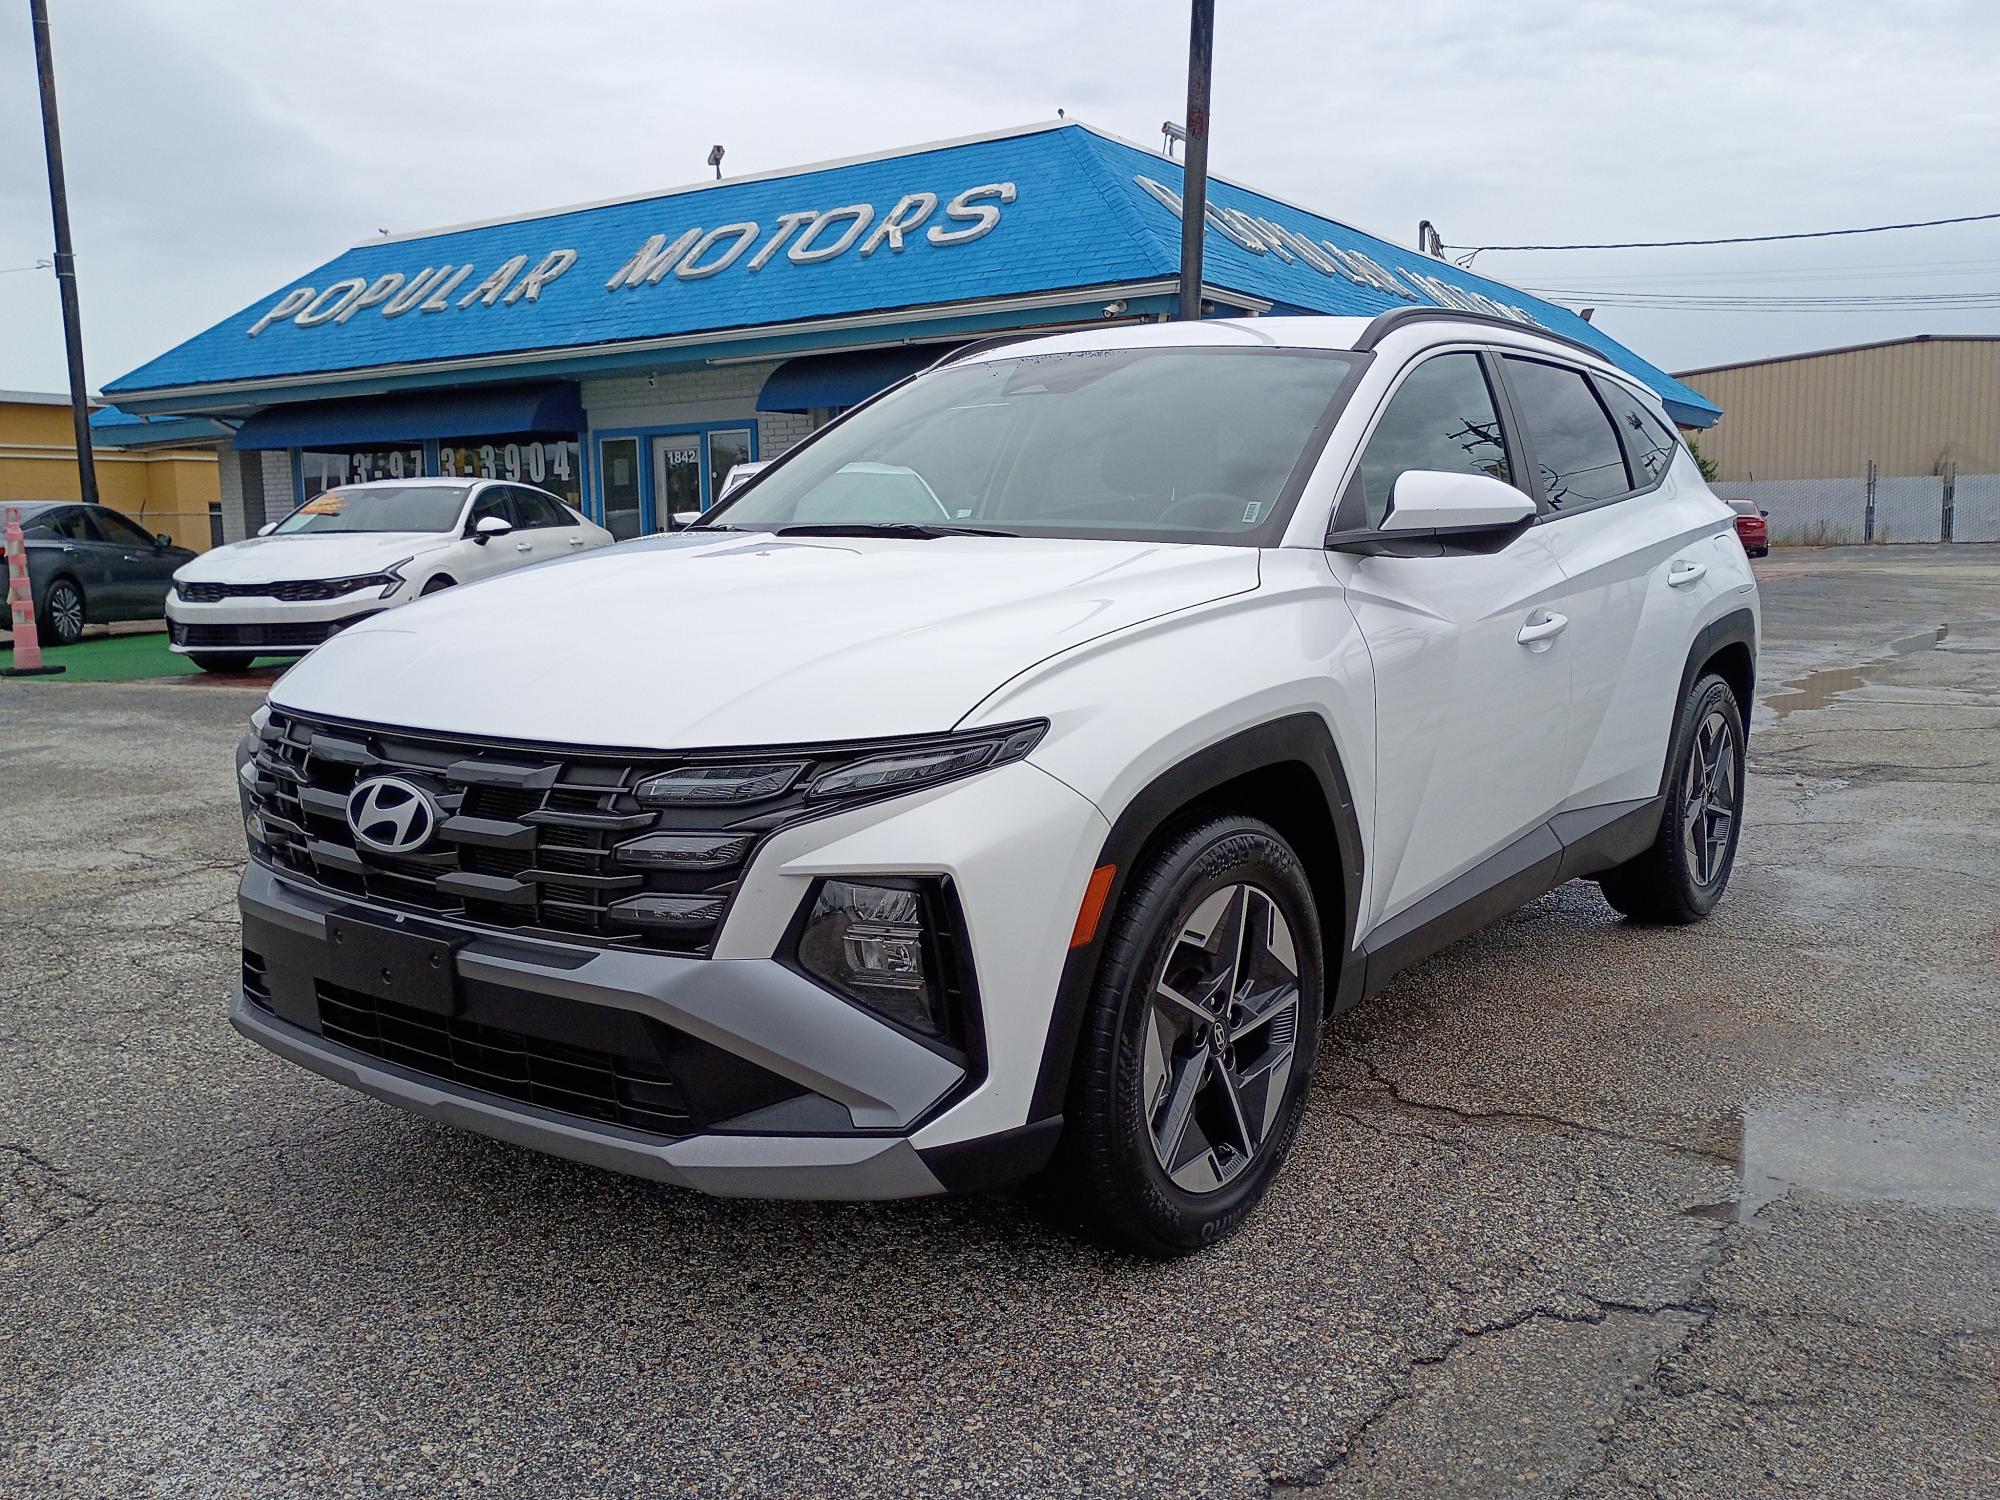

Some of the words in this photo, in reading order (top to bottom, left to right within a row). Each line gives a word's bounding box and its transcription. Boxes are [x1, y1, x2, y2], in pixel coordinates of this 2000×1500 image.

[246, 249, 577, 337] POPULAR
[605, 182, 1017, 292] MOTORS
[667, 450, 697, 464] 1842
